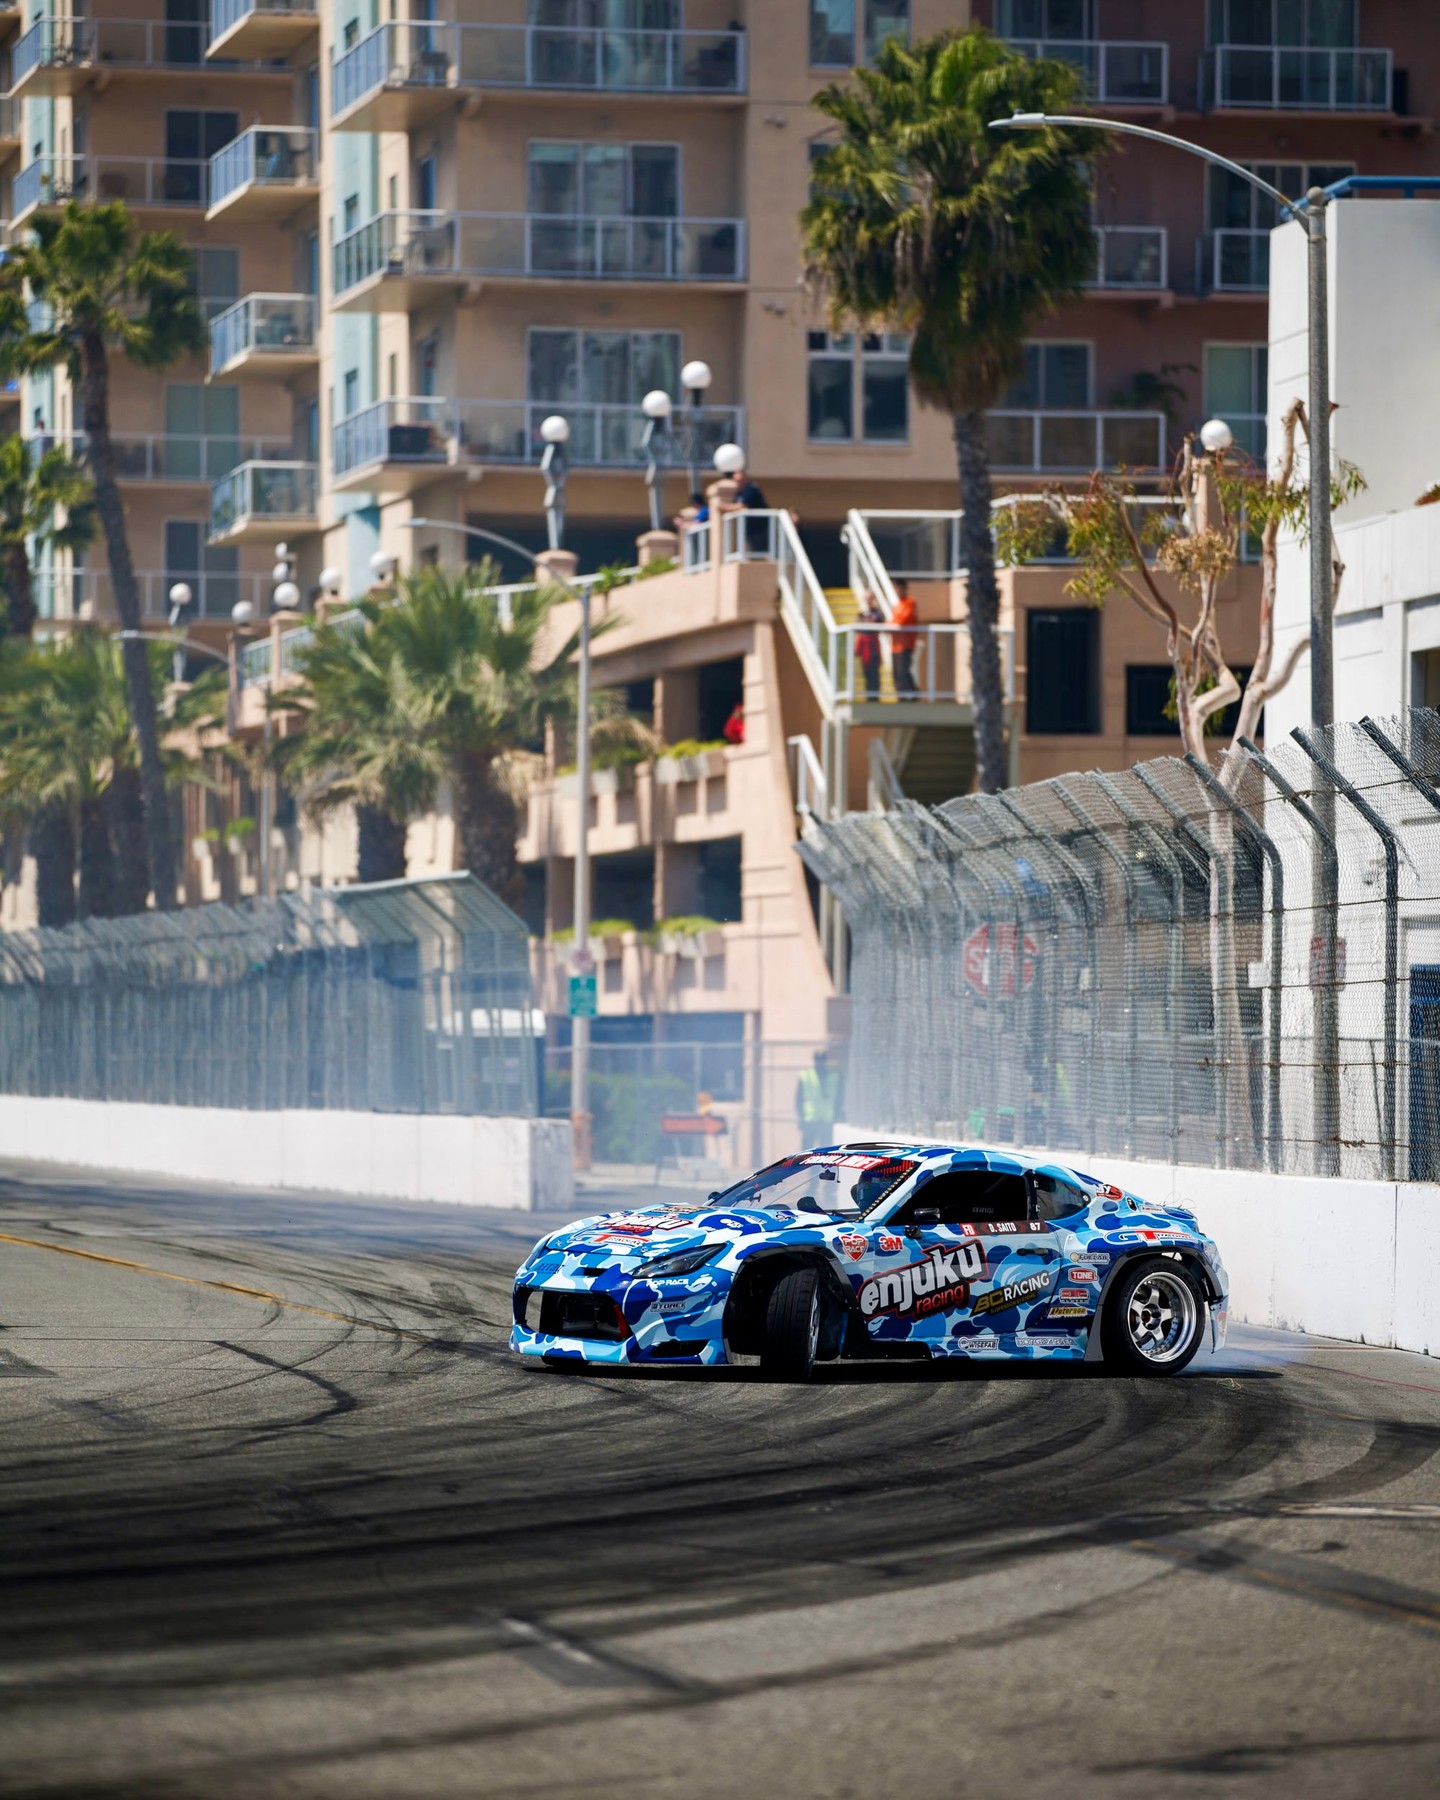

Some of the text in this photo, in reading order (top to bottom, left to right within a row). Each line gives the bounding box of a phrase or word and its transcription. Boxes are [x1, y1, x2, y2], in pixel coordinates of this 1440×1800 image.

[962, 1222, 1040, 1236] FD D. SAITO 87
[845, 1238, 864, 1246] POP
[879, 1236, 904, 1251] 3M
[666, 1278, 689, 1286] RACE
[861, 1243, 982, 1315] enjuku
[1072, 1271, 1093, 1280] TONE
[916, 1284, 964, 1314] racing
[973, 1290, 1004, 1314] BC
[1004, 1273, 1050, 1302] RACING
[969, 1340, 996, 1349] WISEFAB
